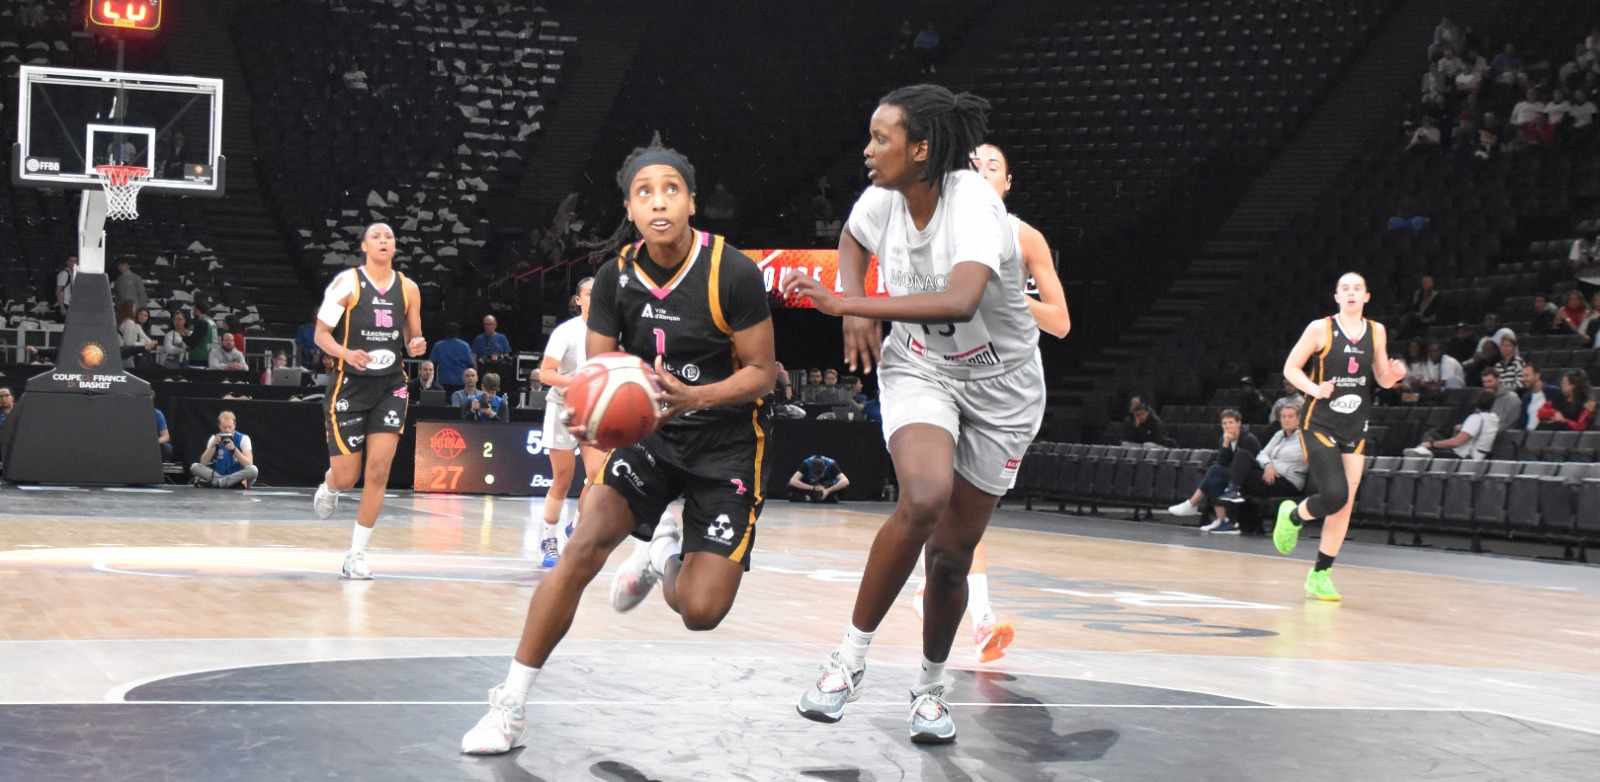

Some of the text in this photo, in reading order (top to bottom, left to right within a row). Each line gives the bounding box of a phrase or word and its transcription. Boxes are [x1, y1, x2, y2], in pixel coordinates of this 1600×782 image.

[652, 327, 666, 355] 1
[52, 373, 82, 381] COUPE
[92, 374, 127, 383] FRANCE
[79, 381, 111, 389] BASKET
[483, 442, 493, 458] 2
[430, 465, 465, 490] 27
